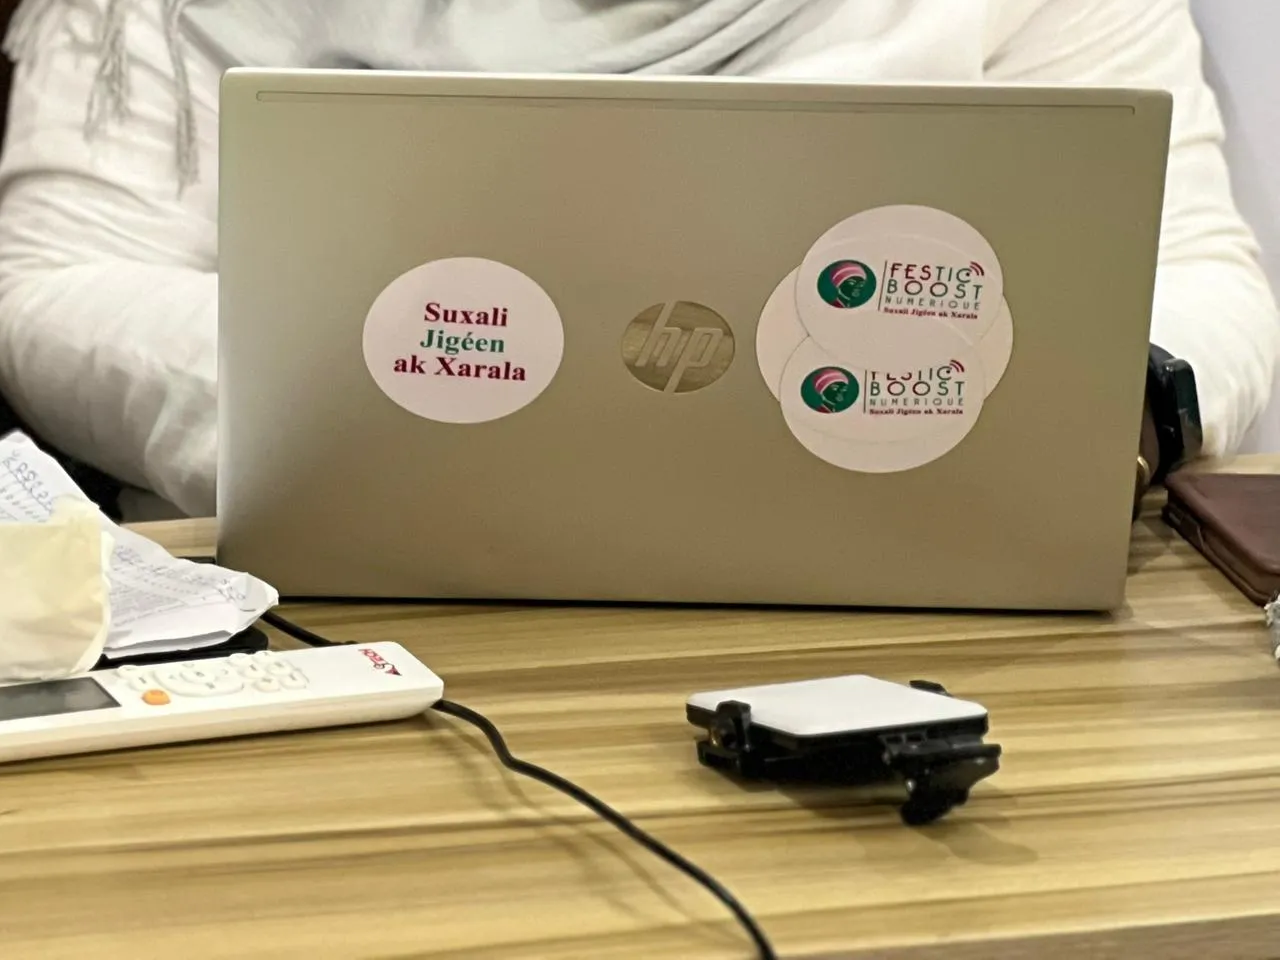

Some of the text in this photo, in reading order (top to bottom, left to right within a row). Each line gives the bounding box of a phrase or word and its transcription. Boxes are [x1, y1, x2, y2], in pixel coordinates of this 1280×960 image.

[890, 262, 973, 284] FESTIC
[886, 278, 983, 300] BOOST
[423, 302, 508, 327] Suxali
[884, 295, 981, 311] NUMERIQUE
[420, 329, 505, 356] Jigéen
[634, 300, 724, 393] hp
[393, 355, 526, 382] ak Xarala
[870, 381, 965, 396] BOOST
